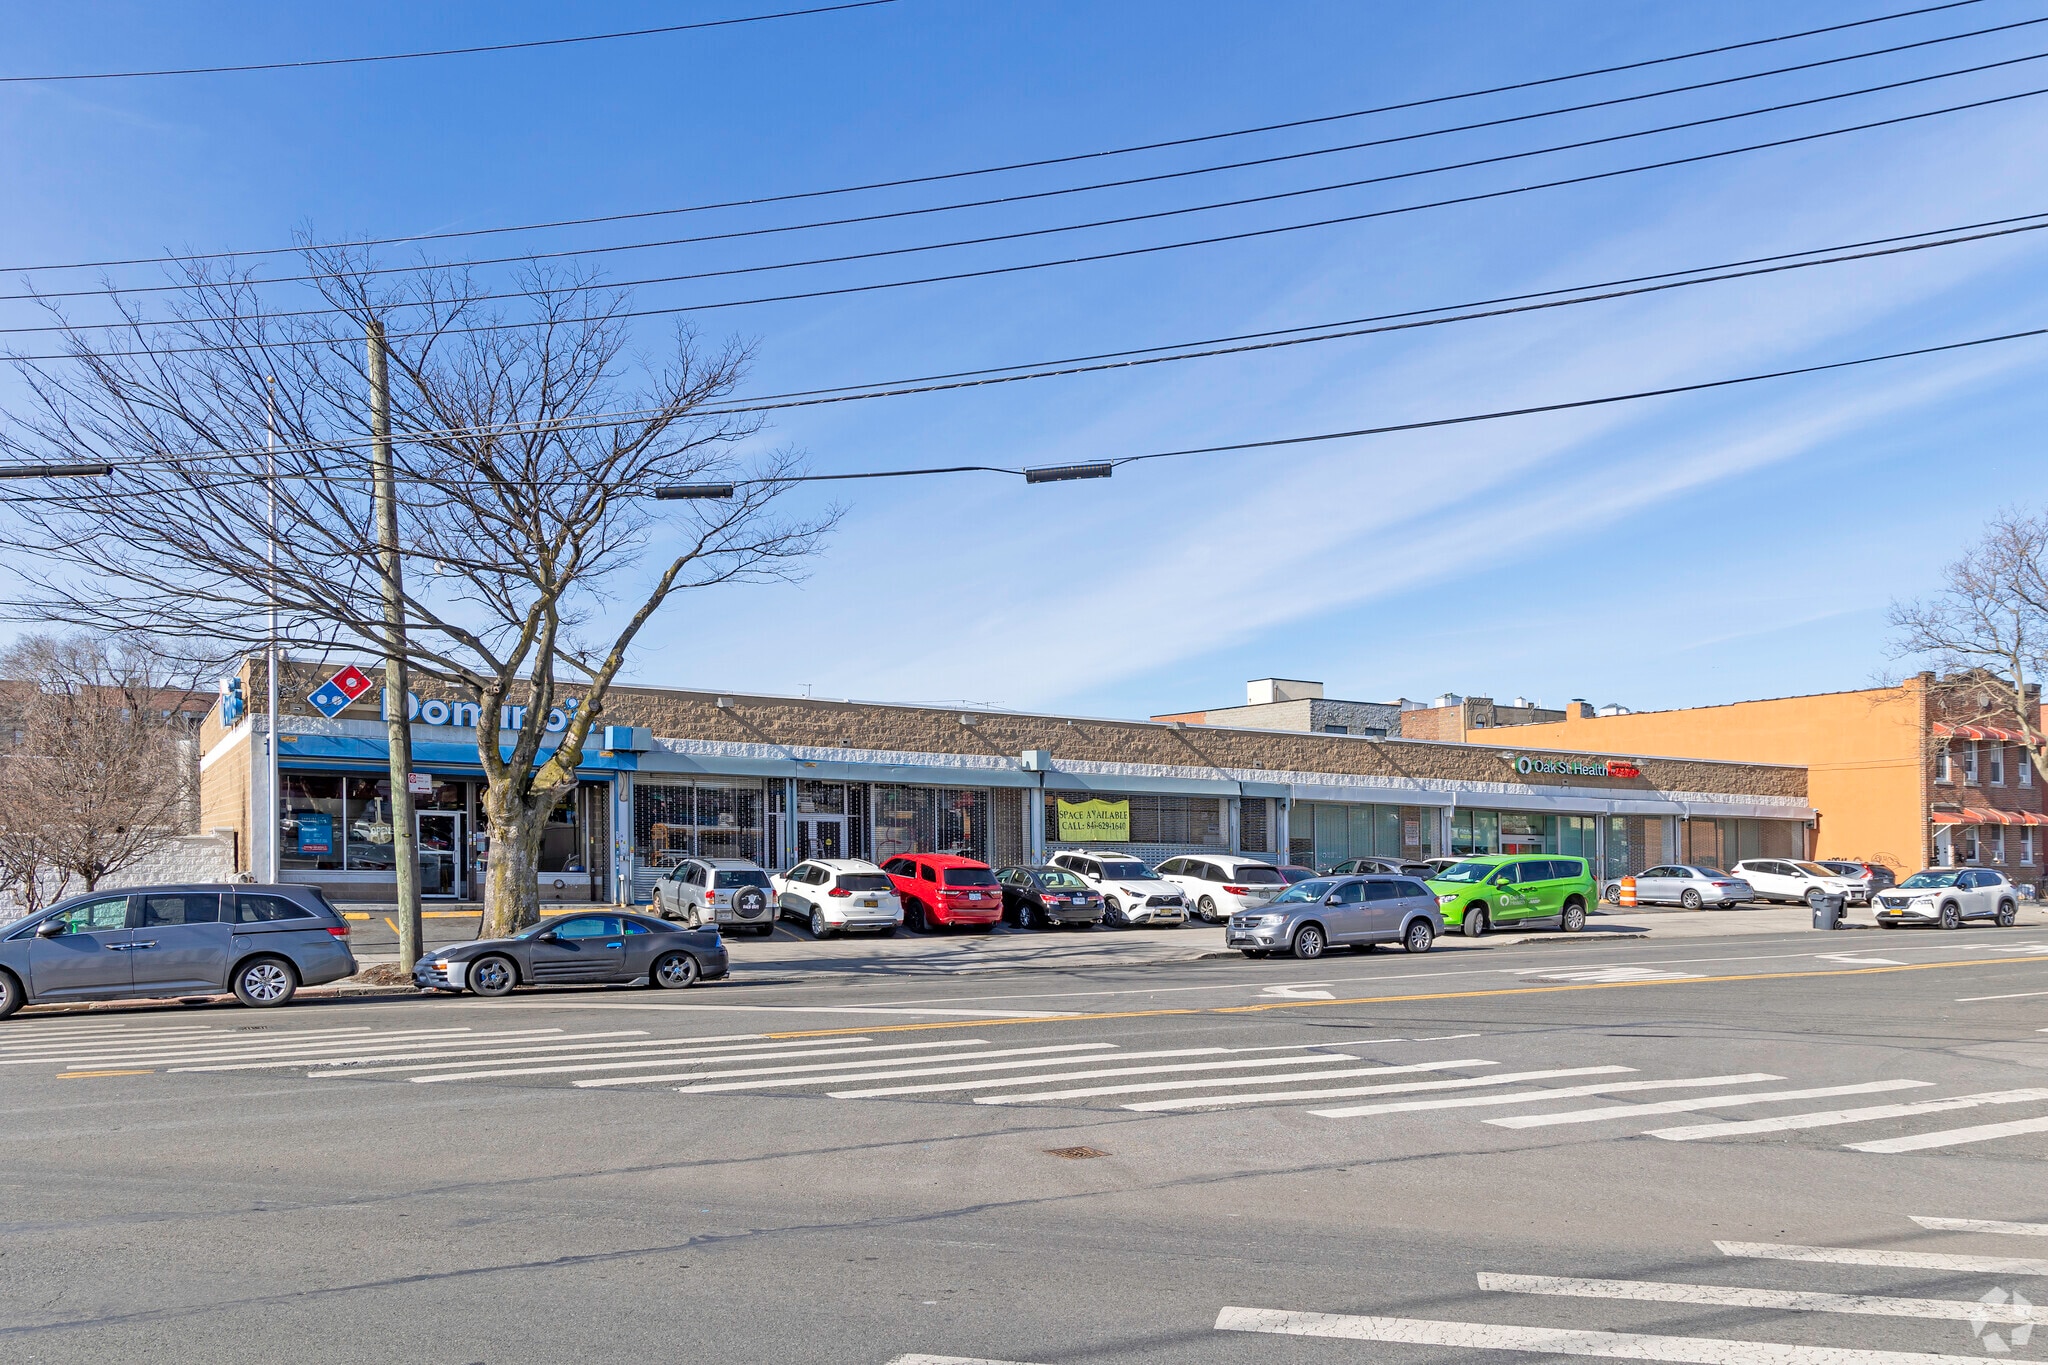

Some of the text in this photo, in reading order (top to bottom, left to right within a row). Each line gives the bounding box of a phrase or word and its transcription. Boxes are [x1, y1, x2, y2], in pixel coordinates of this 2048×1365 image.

[1533, 760, 1557, 773] Oak
[1574, 762, 1608, 776] Health
[1059, 810, 1128, 820] SPACE AVAILABLE
[370, 826, 391, 835] OPEN
[1062, 822, 1085, 830] CALL:
